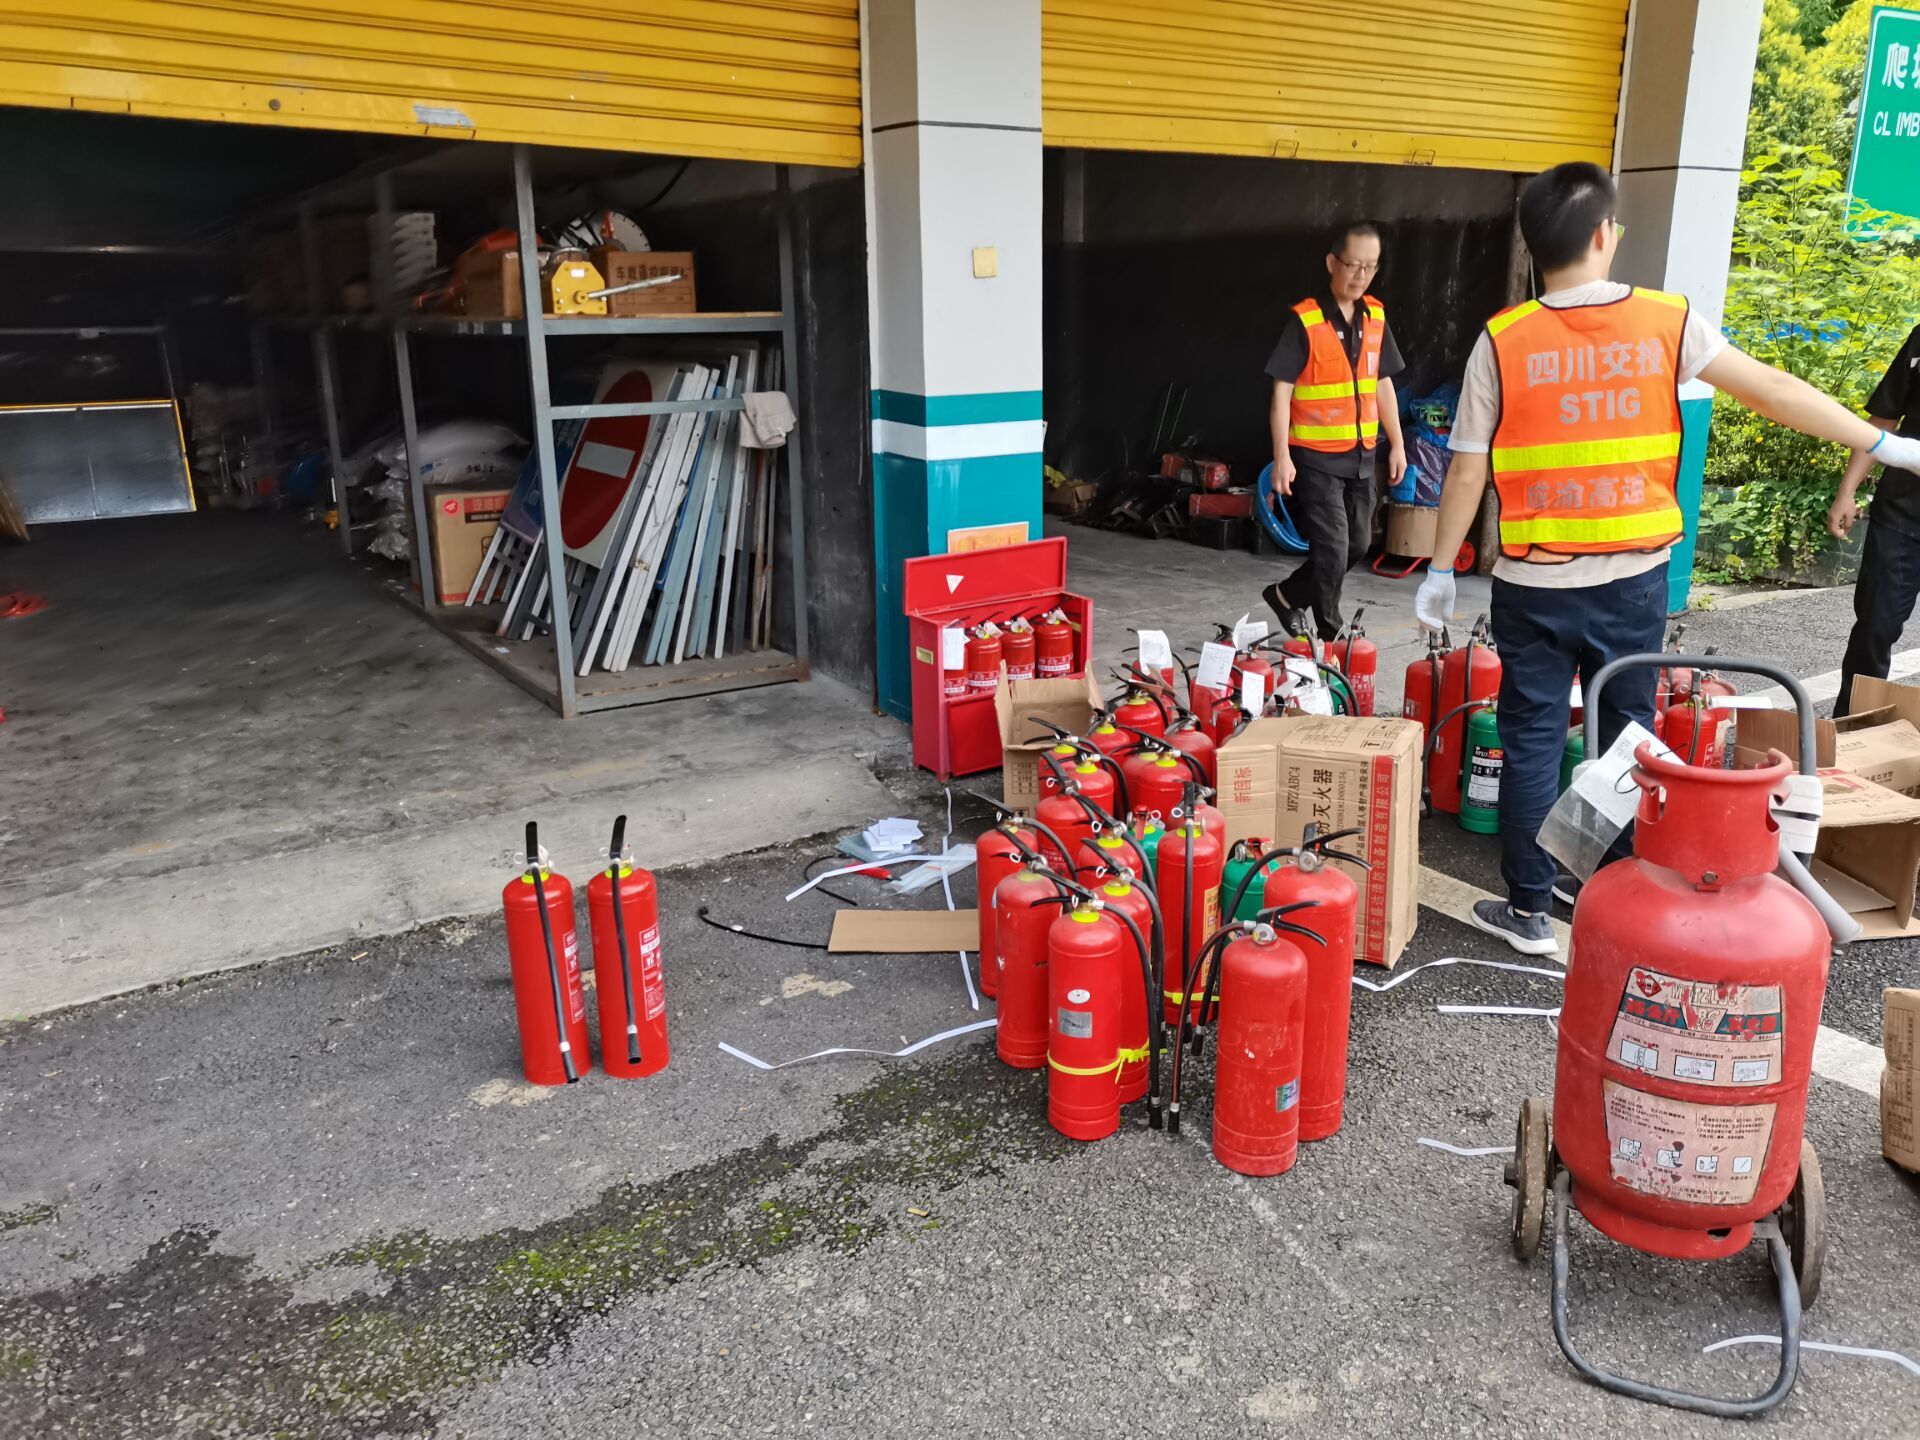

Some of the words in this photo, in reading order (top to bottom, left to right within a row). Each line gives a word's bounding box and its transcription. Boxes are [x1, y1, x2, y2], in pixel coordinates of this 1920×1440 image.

[1527, 338, 1665, 387] 四川交投
[1559, 387, 1642, 425] STIG
[1233, 766, 1252, 805] 新国标
[1312, 768, 1334, 842] 粉灭火器
